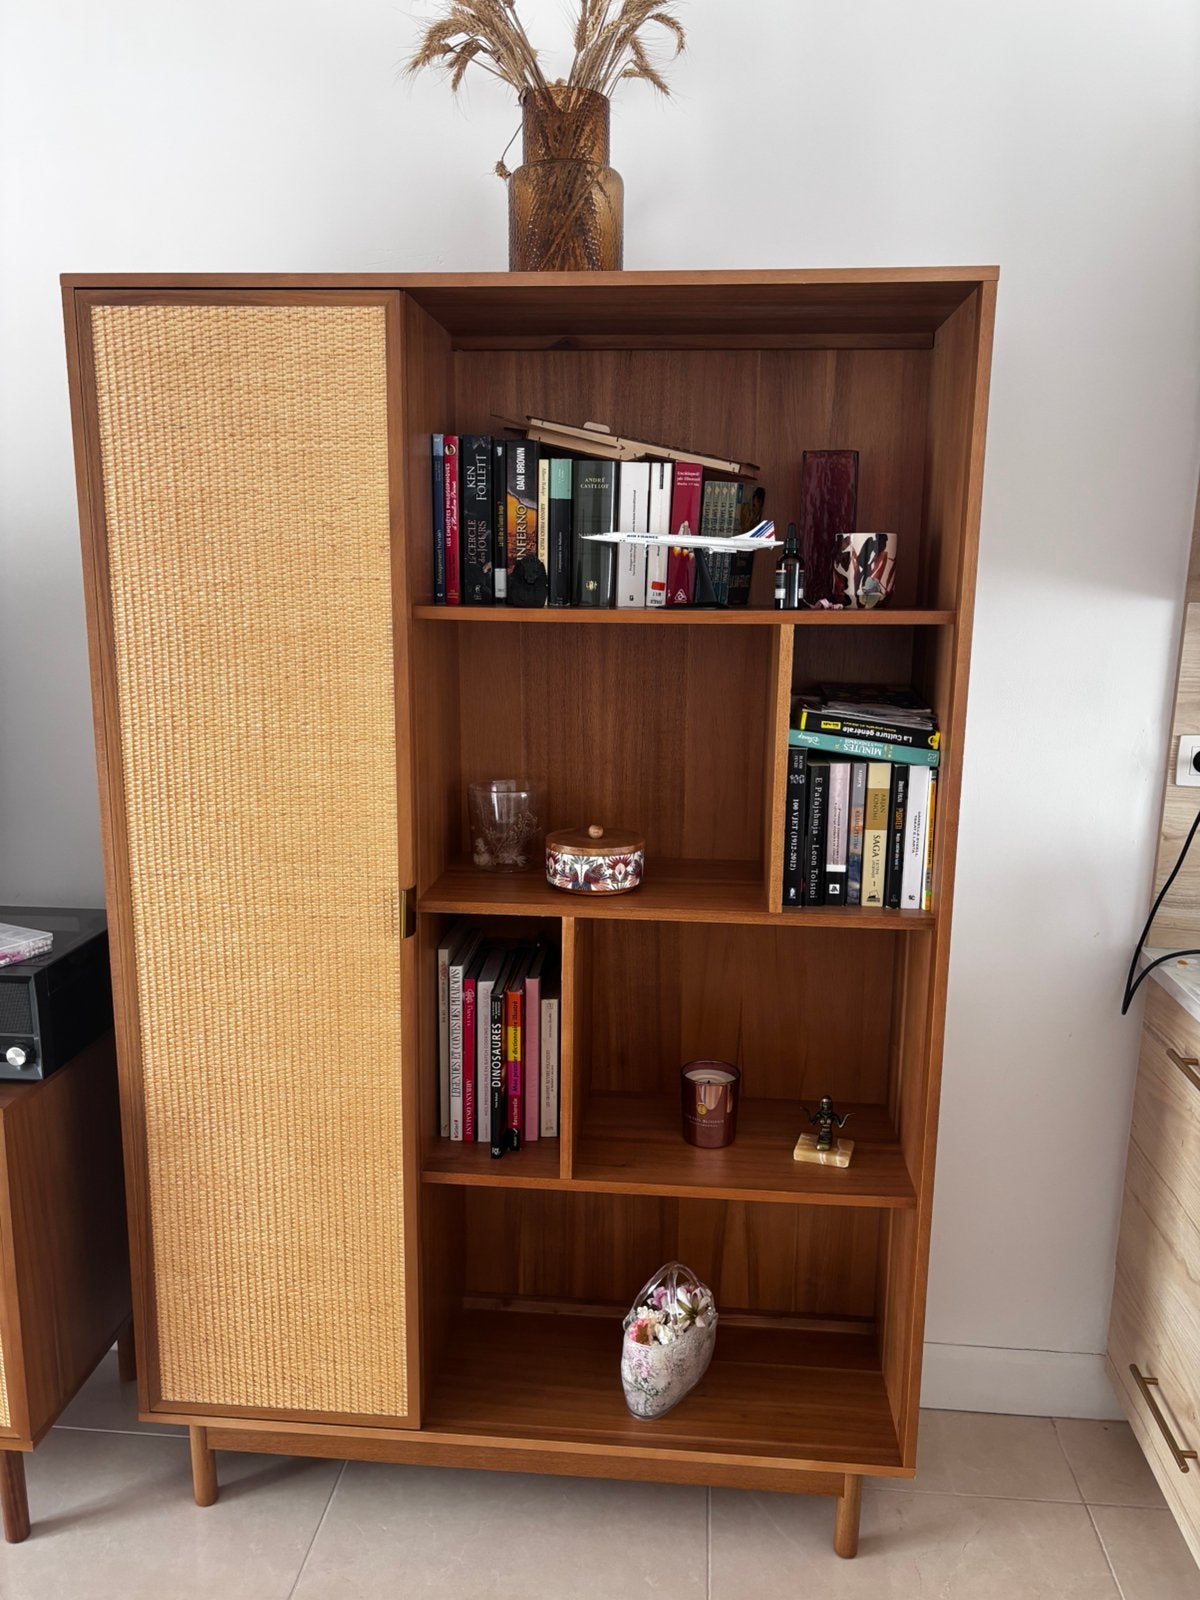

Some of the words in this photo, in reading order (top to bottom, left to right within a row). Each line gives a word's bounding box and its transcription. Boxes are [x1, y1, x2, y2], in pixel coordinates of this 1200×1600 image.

[516, 448, 525, 474] BROWN
[467, 466, 475, 488] KEN
[476, 454, 487, 500] FOLLETT
[516, 475, 525, 490] DAN
[468, 520, 476, 556] CERCLE
[477, 521, 487, 552] JOURS
[516, 504, 527, 560] INFERNO
[842, 726, 875, 738] générale
[875, 731, 902, 741] Culture
[843, 743, 882, 756] MINUTES
[811, 787, 822, 834] Pafajshmja
[789, 831, 798, 871] (1912-2012)
[872, 835, 880, 857] SAGA
[810, 869, 818, 898] Tolstoi
[450, 968, 460, 1006] PHARAONS
[451, 1008, 460, 1021] DES
[451, 1022, 461, 1050] CONTES
[451, 1051, 461, 1060] ET
[492, 1023, 502, 1087] DINOSAURES
